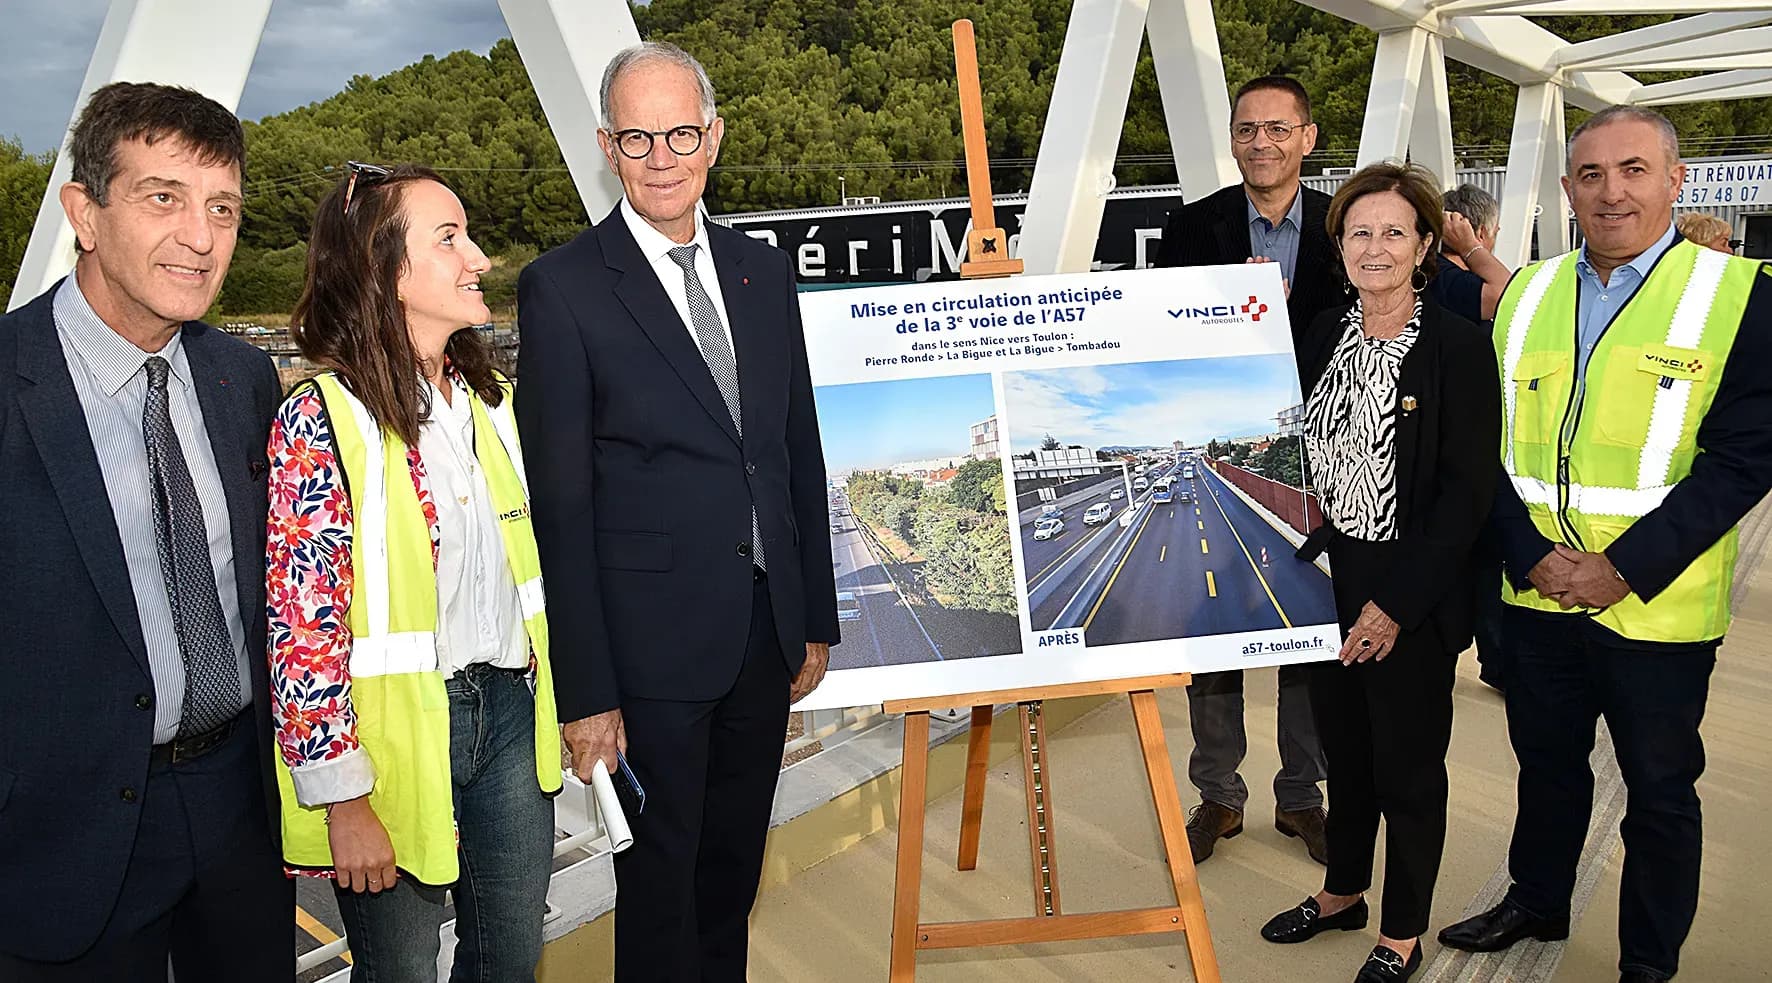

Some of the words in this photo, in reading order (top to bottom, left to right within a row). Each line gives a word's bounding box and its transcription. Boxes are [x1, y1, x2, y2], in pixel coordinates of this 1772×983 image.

[1691, 187, 1708, 204] 57
[1715, 186, 1733, 202] 48
[1741, 185, 1758, 202] 07
[851, 302, 898, 319] Mise
[903, 302, 926, 315] en
[932, 293, 1032, 312] circulation
[1037, 285, 1123, 306] anticipée
[895, 319, 919, 335] de
[924, 317, 941, 332] la
[968, 312, 1008, 329] voie
[1013, 310, 1036, 326] de
[1041, 307, 1086, 324] l'A57
[1167, 305, 1236, 319] VINCI
[911, 341, 937, 351] dans
[940, 339, 950, 349] le
[952, 339, 978, 348] sens
[980, 336, 1005, 346] Nice
[1007, 335, 1030, 344] vers
[1032, 332, 1068, 342] Toulon
[865, 356, 898, 367] Pierre
[900, 352, 935, 364] Ronde
[947, 351, 959, 361] La
[962, 349, 993, 361] Bigue
[995, 348, 1007, 357] et
[1009, 346, 1022, 356] La
[1024, 345, 1055, 356] Bigue
[1066, 340, 1121, 352] Tombadou
[1645, 354, 1684, 368] VINCI
[497, 508, 523, 521] INCI
[1039, 630, 1080, 647] APRÈS
[1242, 636, 1324, 655] a57-toulon.fr
